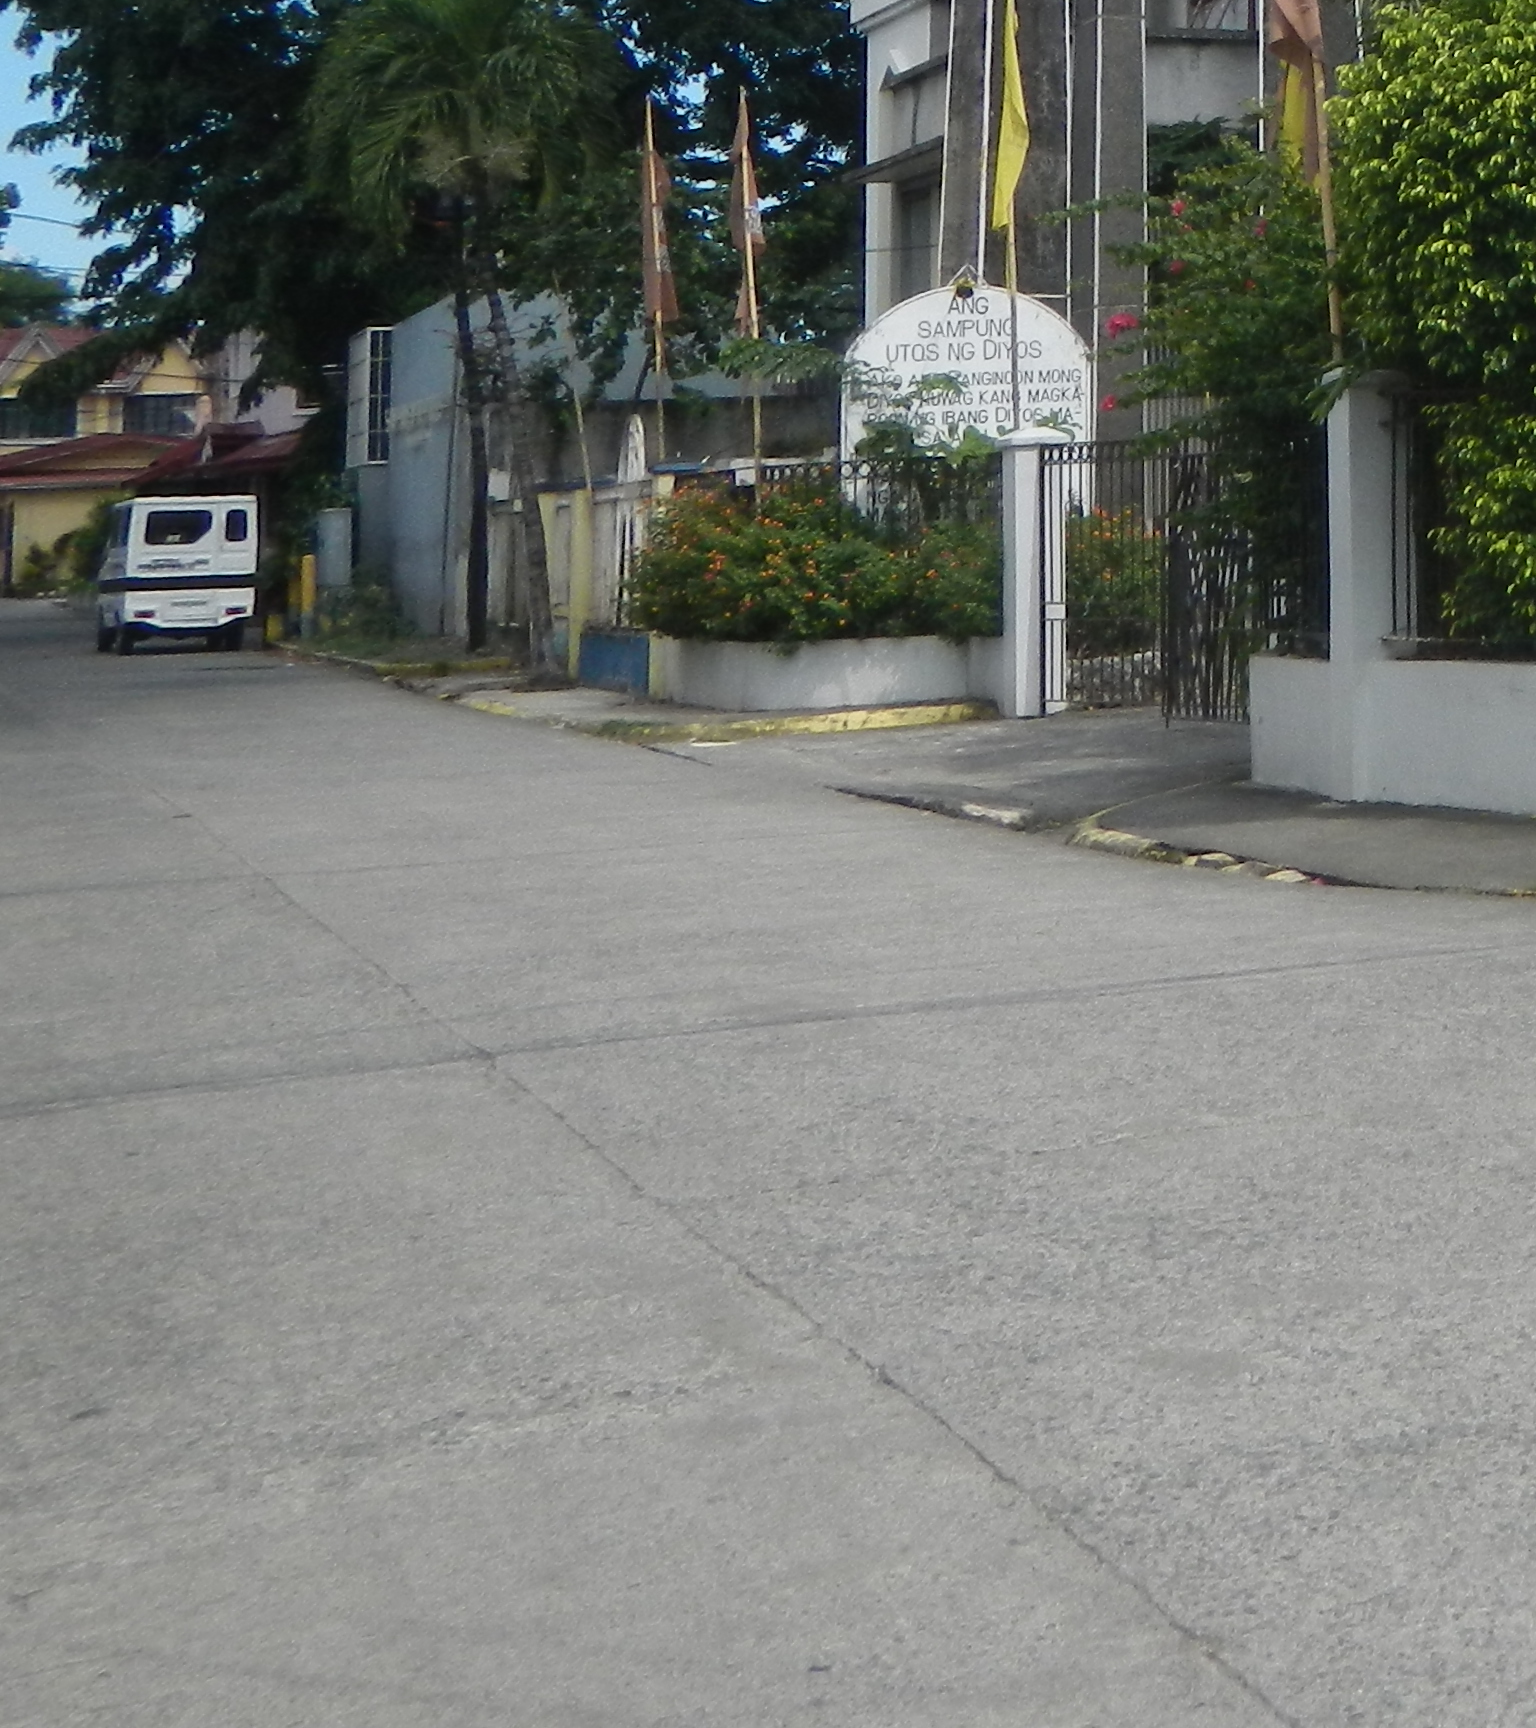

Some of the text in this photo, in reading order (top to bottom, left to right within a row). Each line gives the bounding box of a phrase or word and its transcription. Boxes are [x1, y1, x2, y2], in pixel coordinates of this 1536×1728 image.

[948, 297, 990, 315] ANG
[917, 318, 1013, 339] SAMPUNG
[948, 341, 976, 361] NG
[983, 339, 1043, 361] DIYOS
[1038, 368, 1082, 384] MONG
[978, 389, 1021, 405] KAN
[1027, 386, 1085, 403] MAGKA-
[942, 409, 988, 425] IBANG
[995, 406, 1043, 423] DIOS
